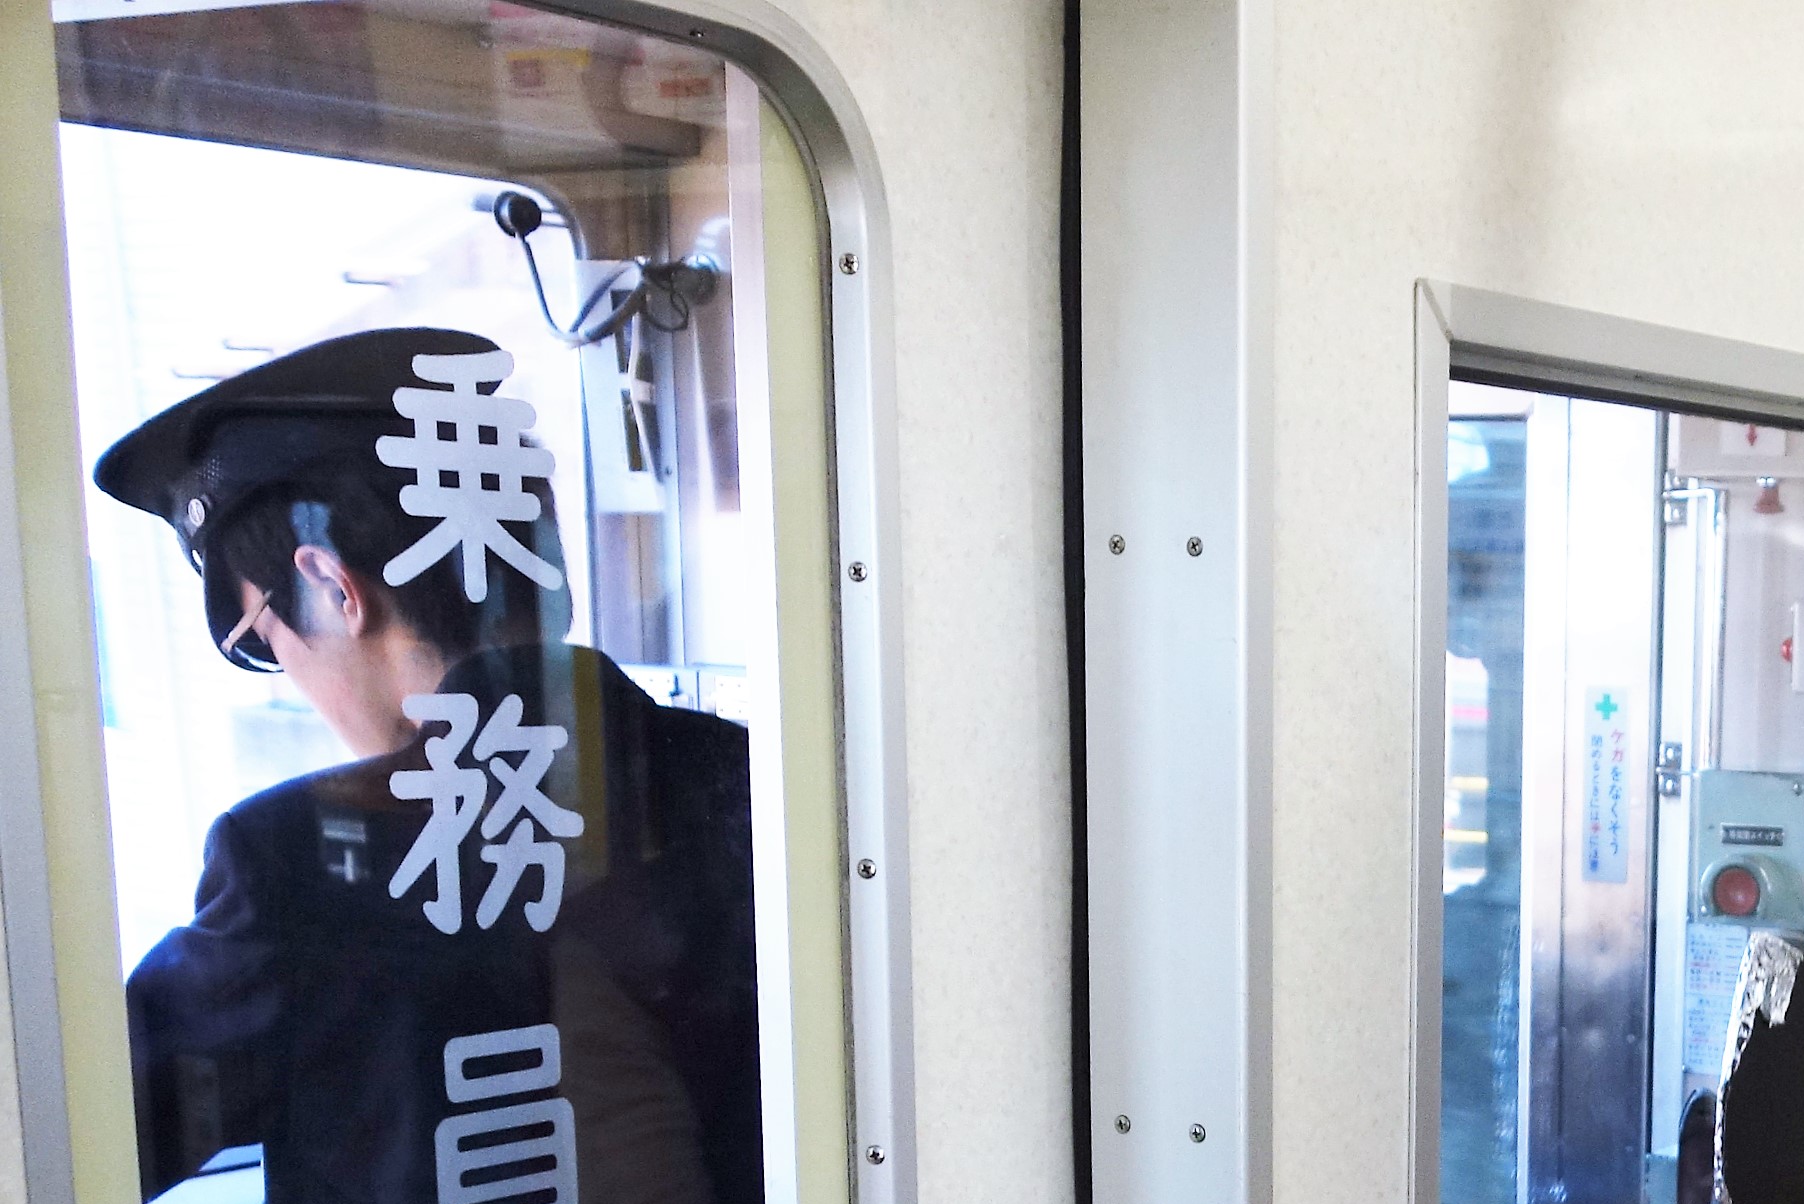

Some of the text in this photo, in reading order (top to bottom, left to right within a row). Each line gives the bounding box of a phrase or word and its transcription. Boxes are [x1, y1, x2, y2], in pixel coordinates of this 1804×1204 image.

[1608, 729, 1624, 856] ケガをなくそう
